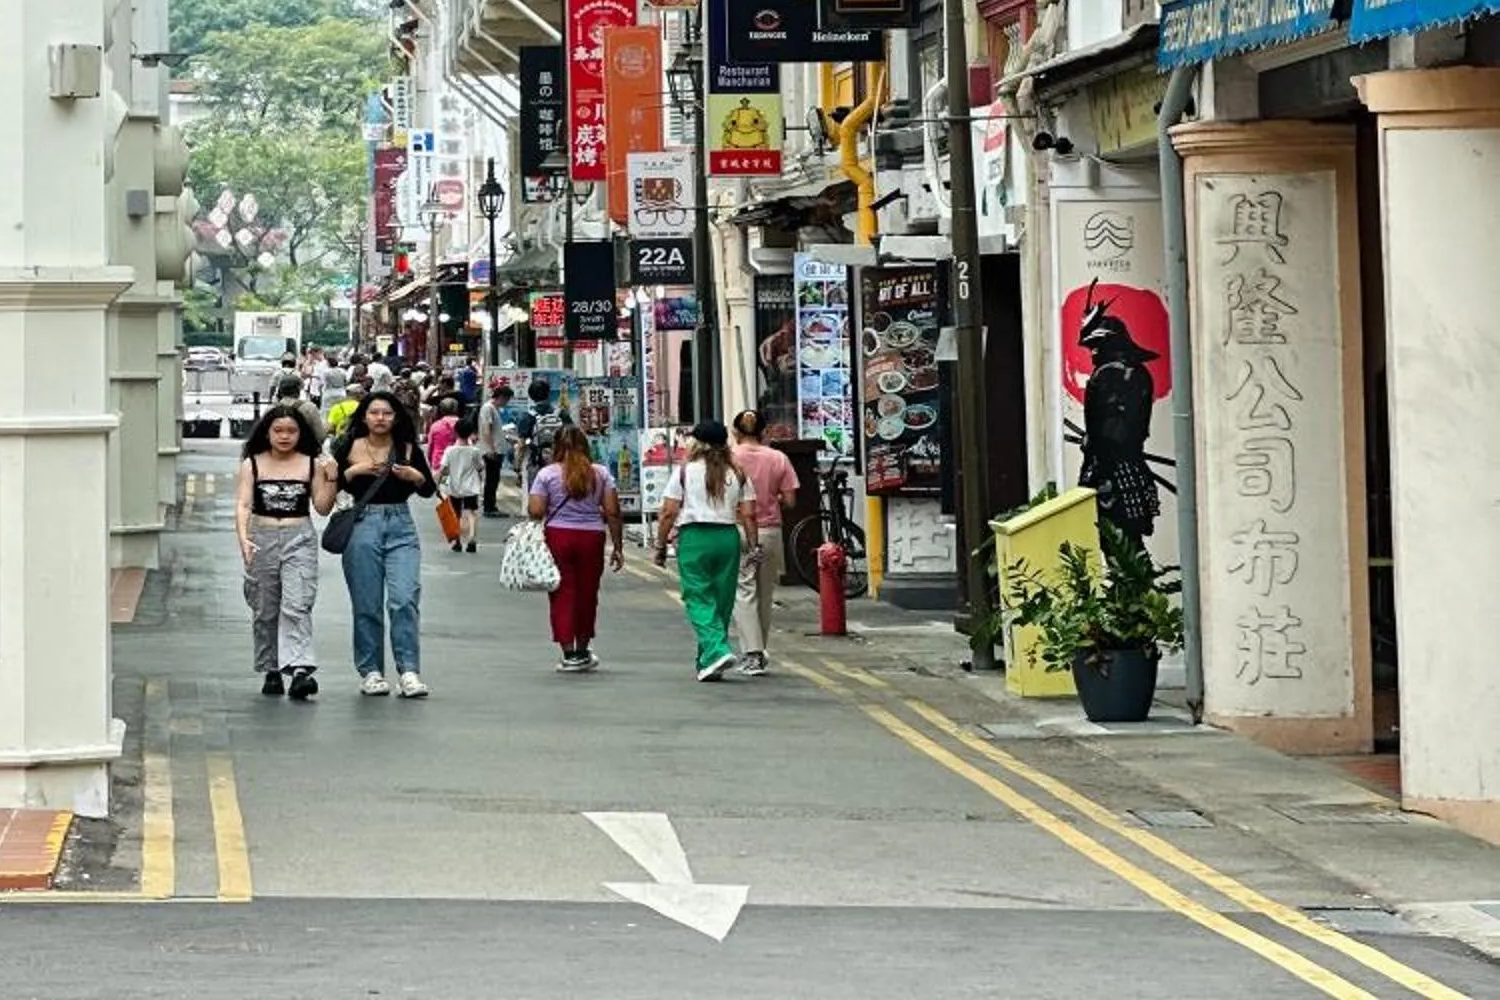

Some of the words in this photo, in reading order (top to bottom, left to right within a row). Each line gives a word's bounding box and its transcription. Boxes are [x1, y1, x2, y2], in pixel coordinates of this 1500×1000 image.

[812, 31, 869, 42] Heineken
[719, 65, 769, 78] Restaurant
[639, 247, 685, 265] 22A
[571, 301, 612, 313] 28/30
